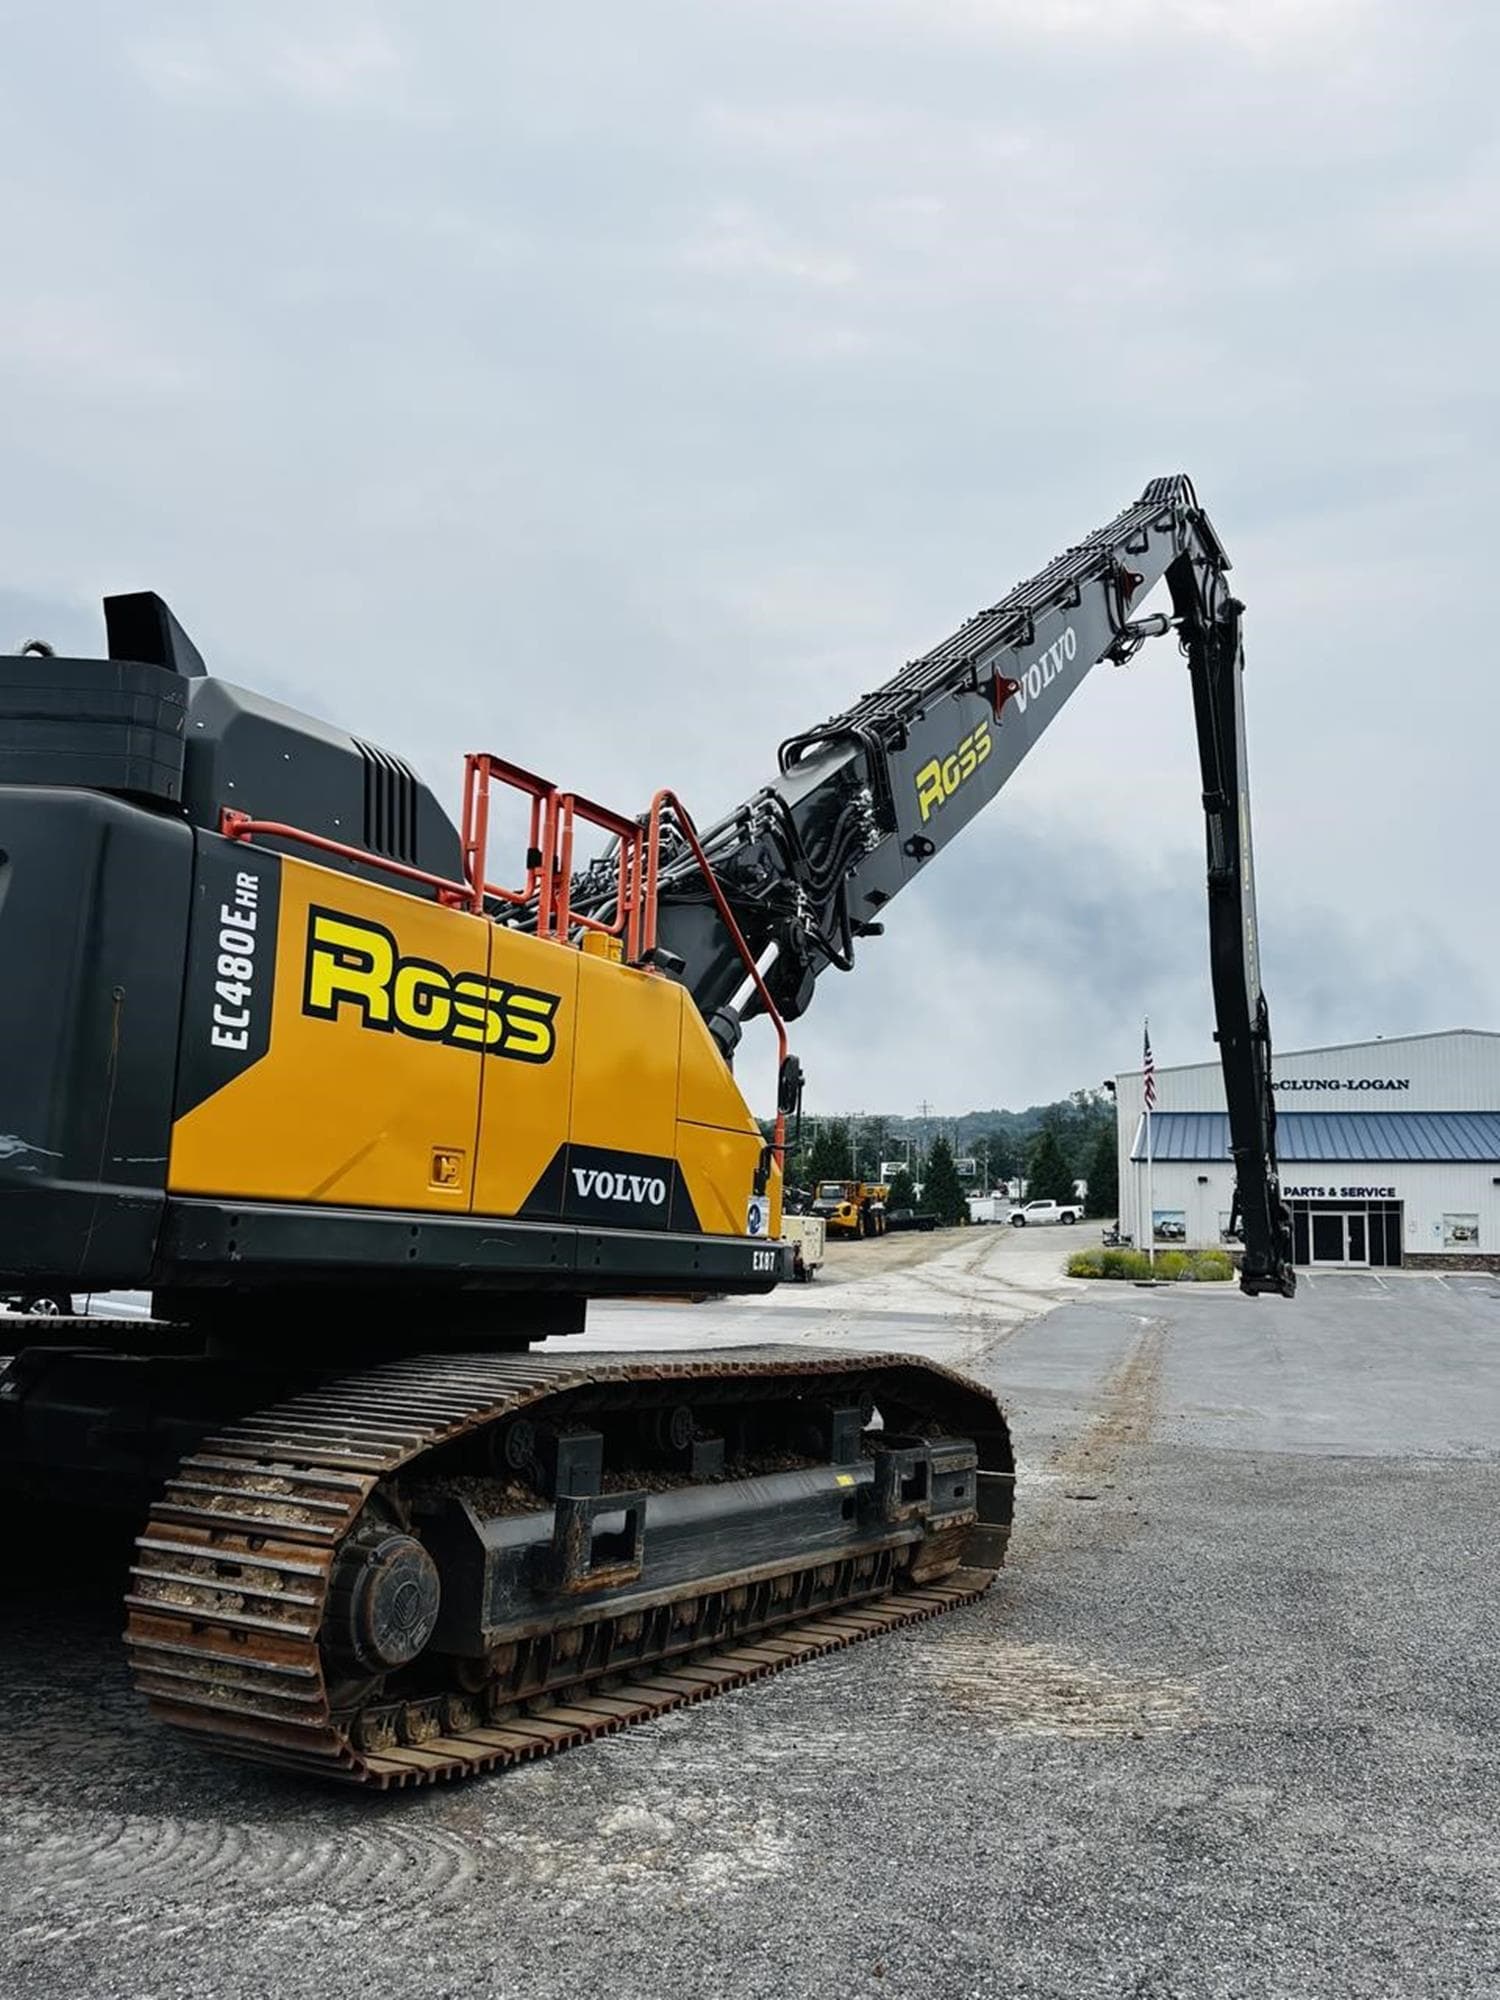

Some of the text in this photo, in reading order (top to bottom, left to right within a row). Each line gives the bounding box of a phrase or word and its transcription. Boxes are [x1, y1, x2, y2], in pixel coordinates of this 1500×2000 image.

[1014, 626, 1077, 713] VOLVO
[915, 720, 992, 822] ROSS
[305, 907, 559, 1062] ROSS
[1271, 1079, 1410, 1091] cCLUNG-LOGAN
[572, 1167, 666, 1205] VOLVO
[1283, 1186, 1396, 1197] PARTS & SERVICE
